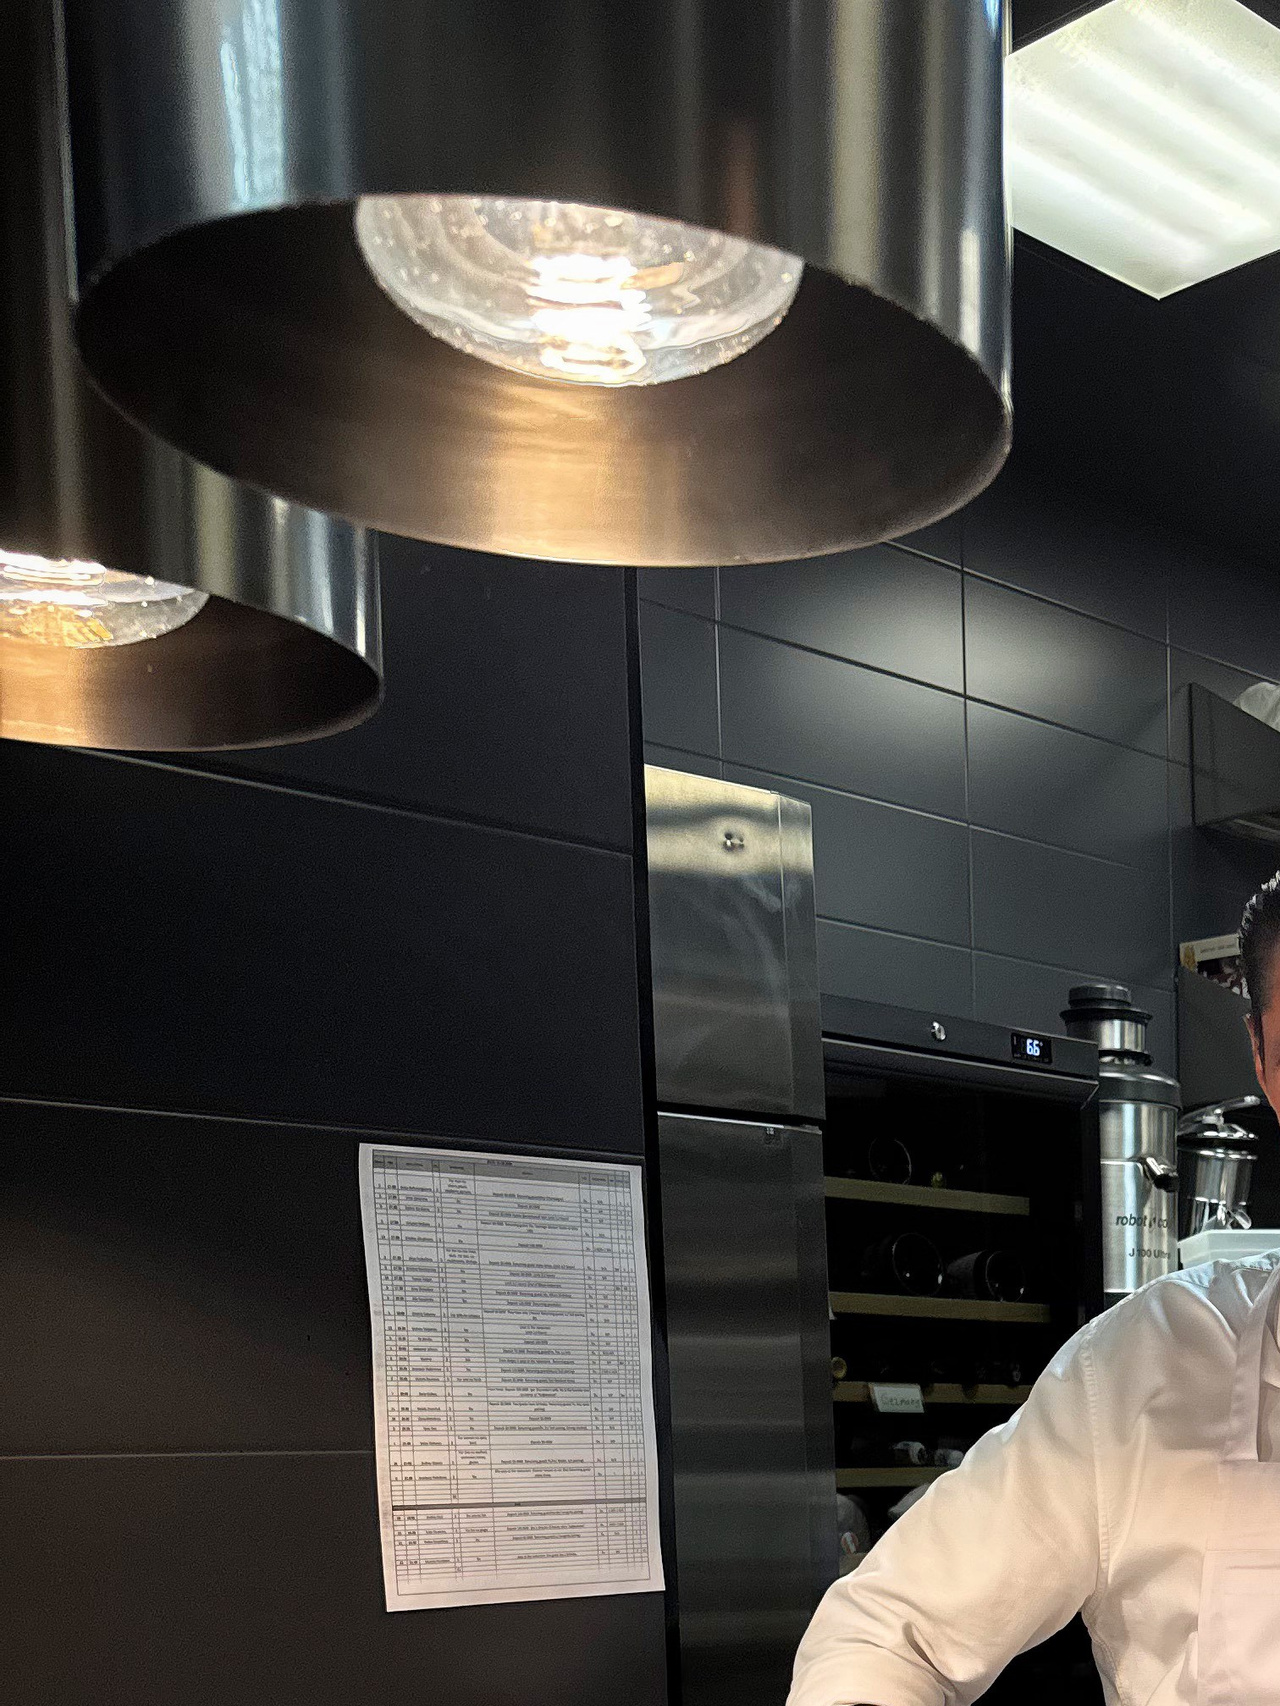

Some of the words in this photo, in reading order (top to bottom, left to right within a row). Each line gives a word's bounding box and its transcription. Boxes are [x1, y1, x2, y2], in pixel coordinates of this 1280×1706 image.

[1115, 1213, 1147, 1227] robot
[1129, 1247, 1135, 1257] J
[1137, 1248, 1152, 1258] 100
